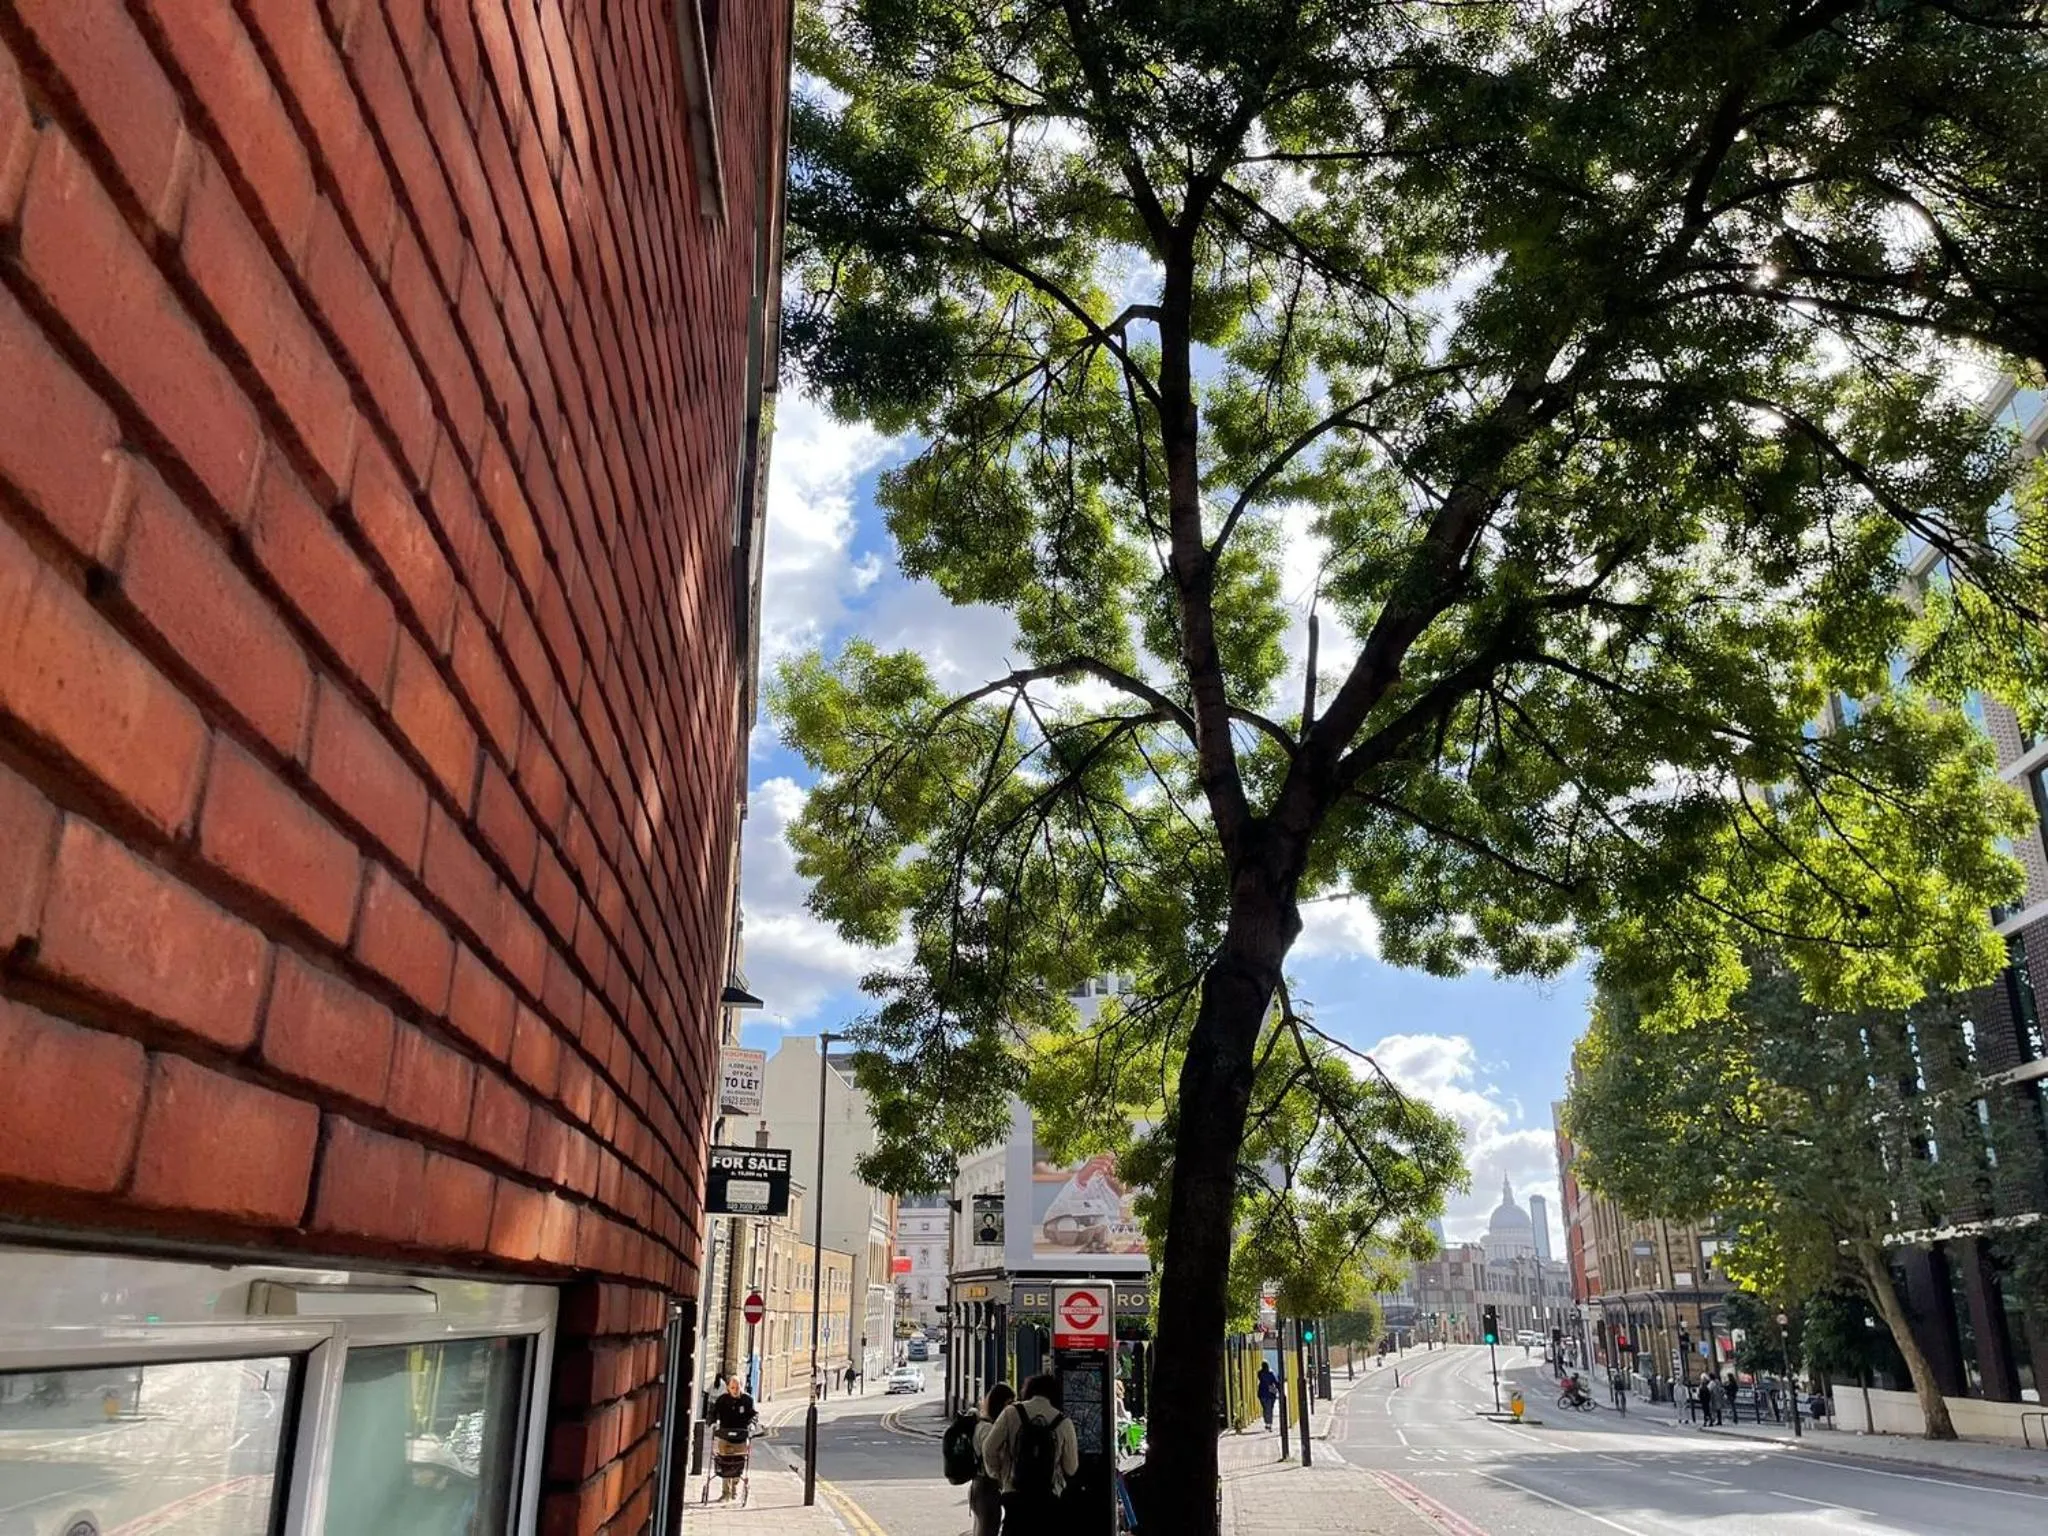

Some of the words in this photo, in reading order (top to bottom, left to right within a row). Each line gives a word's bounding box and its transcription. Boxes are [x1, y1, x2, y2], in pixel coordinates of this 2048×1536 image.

[725, 1077, 738, 1087] TO
[741, 1078, 759, 1090] LET
[711, 1156, 744, 1169] FOR
[748, 1157, 787, 1172] SALE
[1023, 1293, 1049, 1306] BE
